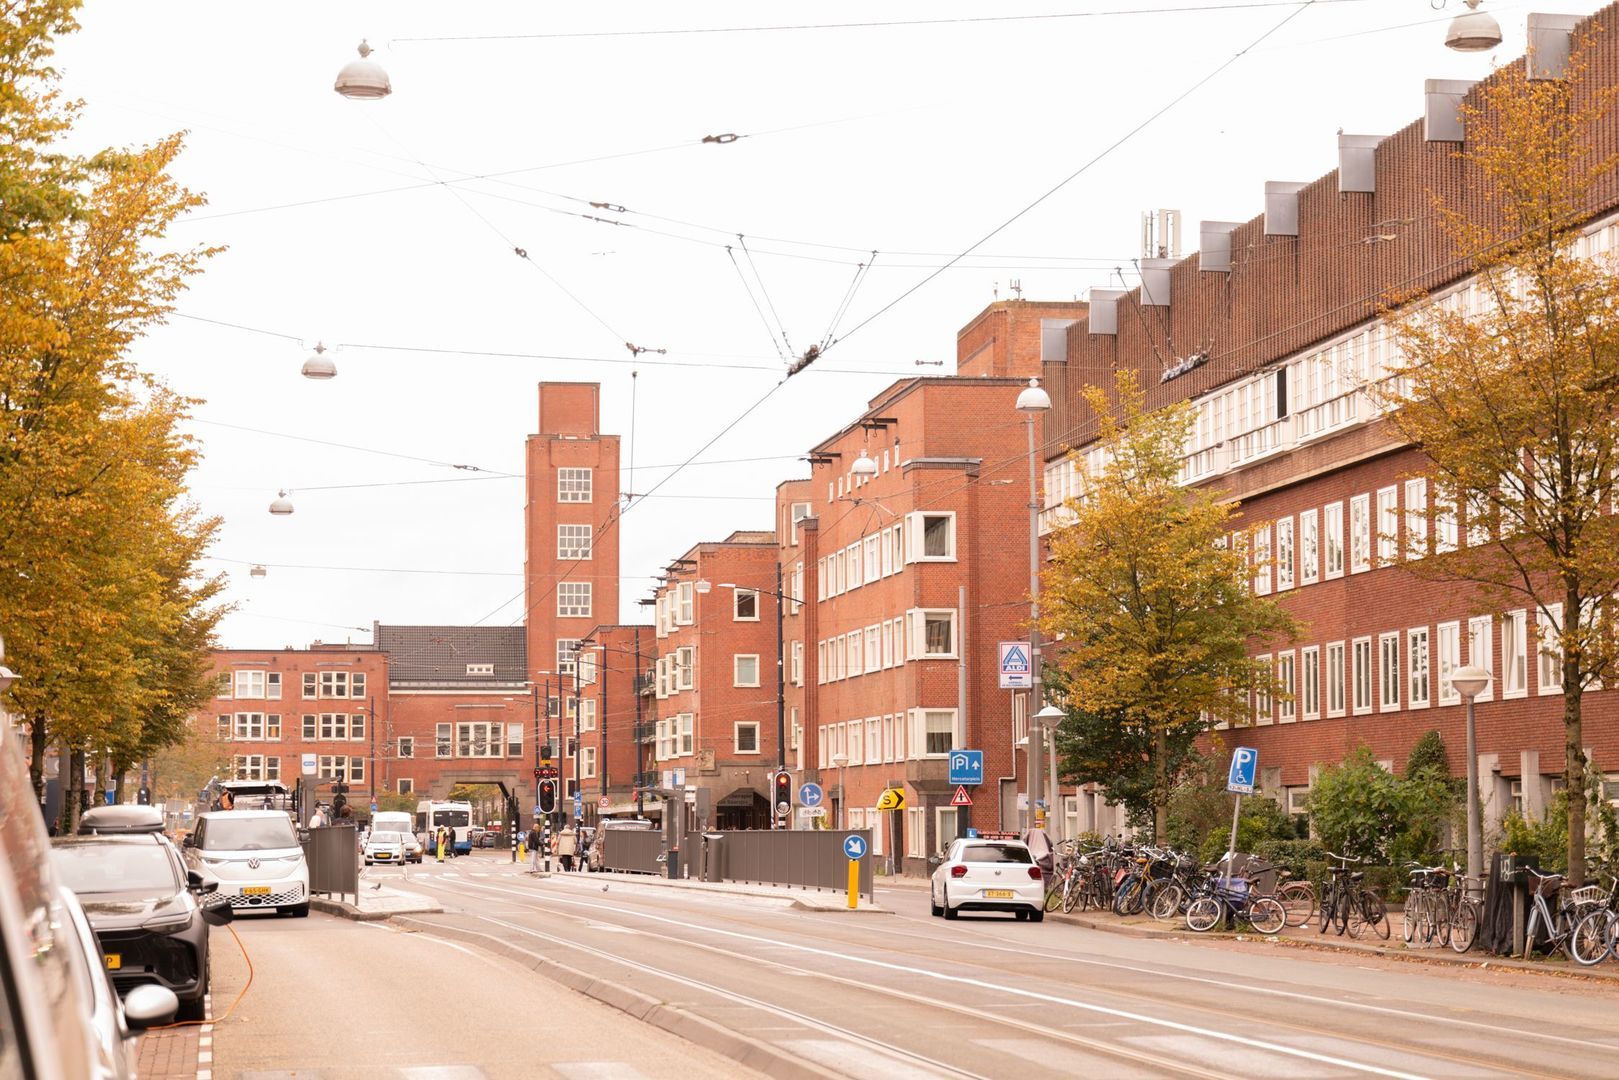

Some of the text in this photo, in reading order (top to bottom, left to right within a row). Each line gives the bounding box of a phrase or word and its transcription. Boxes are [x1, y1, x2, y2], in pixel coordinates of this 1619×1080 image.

[956, 758, 964, 770] P
[1236, 750, 1251, 769] P
[883, 795, 891, 805] S
[969, 830, 975, 838] L
